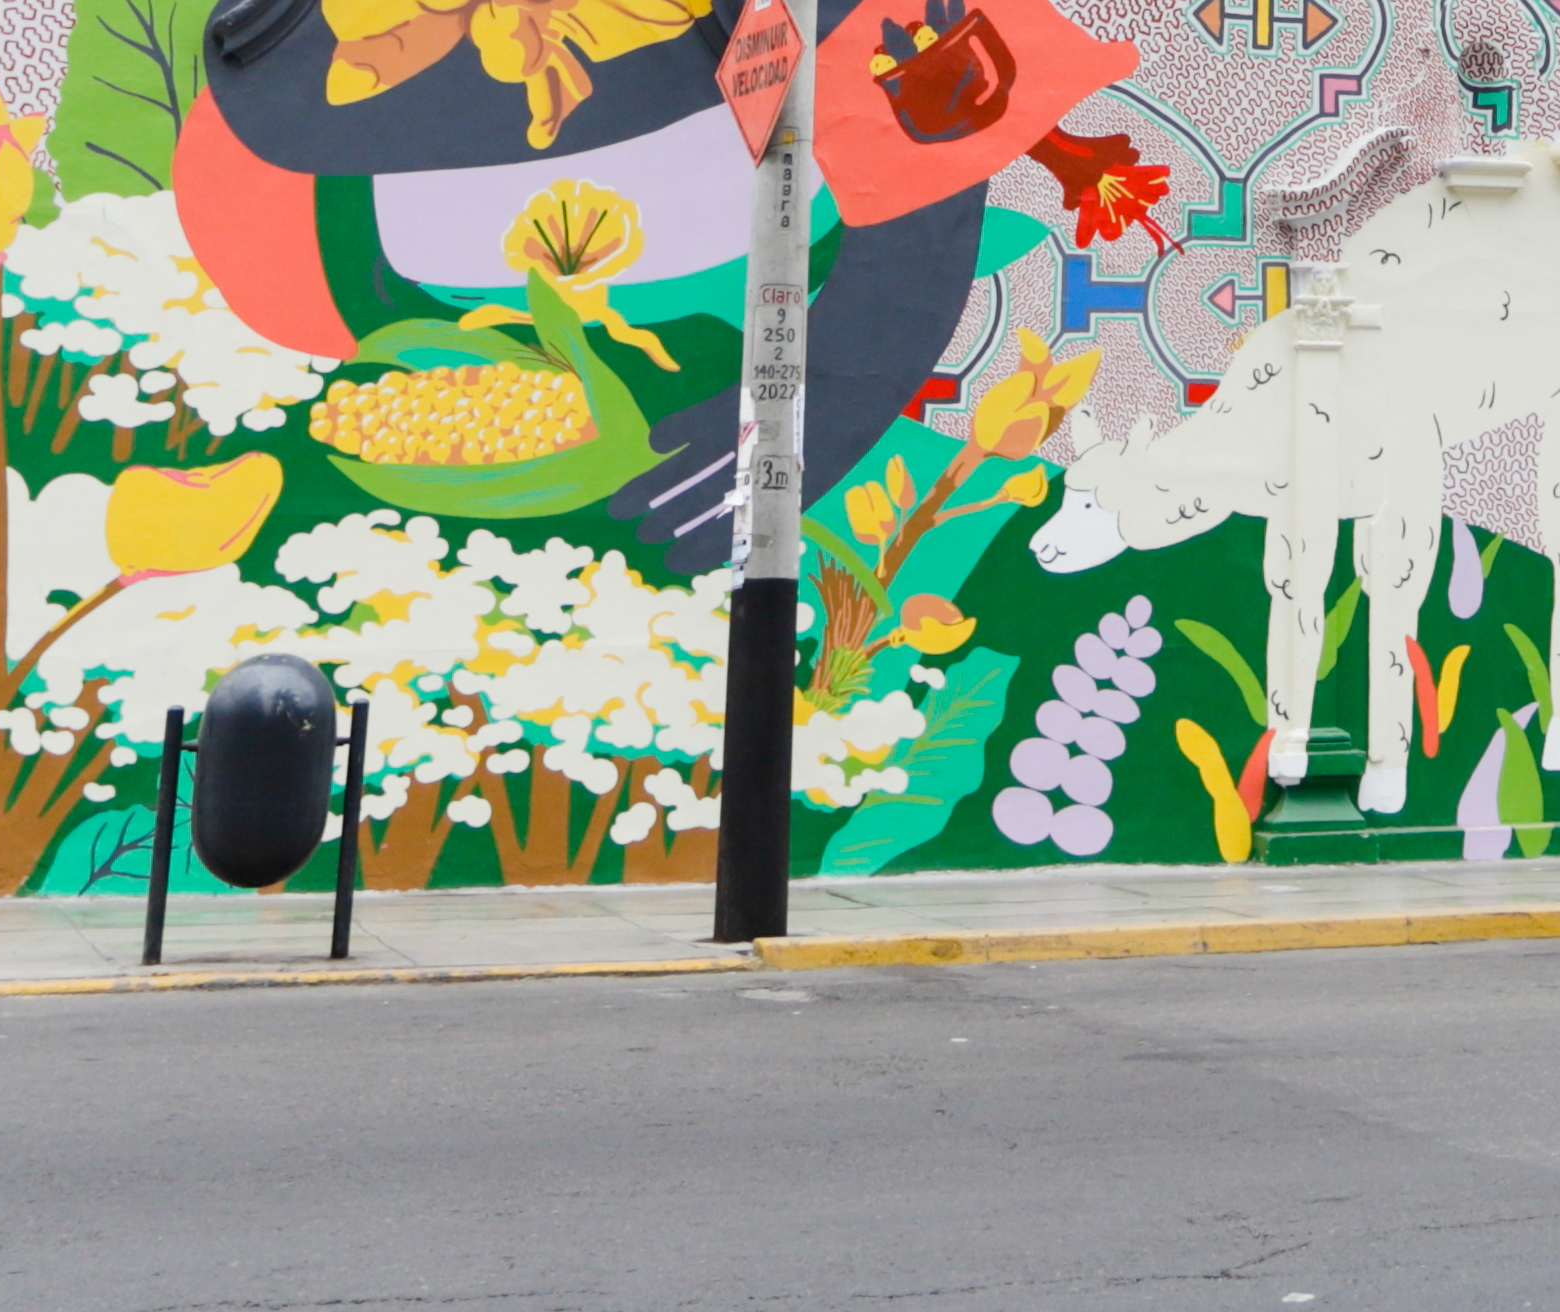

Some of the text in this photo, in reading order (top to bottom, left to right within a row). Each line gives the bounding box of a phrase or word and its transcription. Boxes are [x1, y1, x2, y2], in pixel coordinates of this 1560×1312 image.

[735, 22, 789, 64] DISMINUIR
[732, 56, 789, 99] VELOCIDAD
[762, 287, 801, 305] Claro
[777, 308, 786, 324] 9
[763, 327, 796, 343] 250
[774, 346, 784, 361] 2
[753, 364, 802, 380] 140-275
